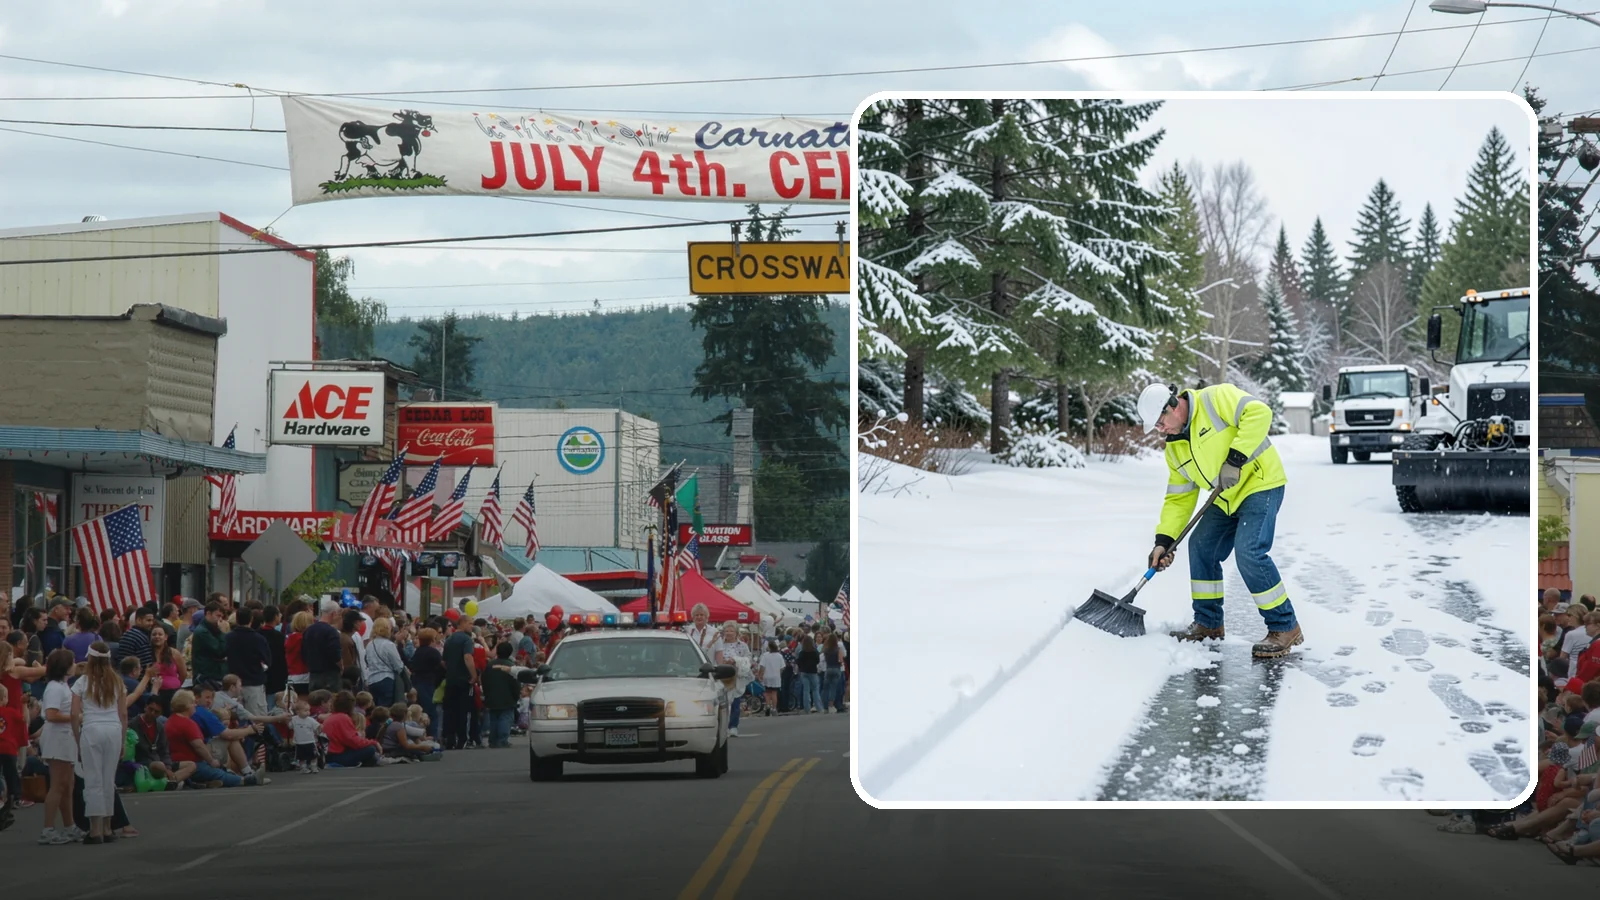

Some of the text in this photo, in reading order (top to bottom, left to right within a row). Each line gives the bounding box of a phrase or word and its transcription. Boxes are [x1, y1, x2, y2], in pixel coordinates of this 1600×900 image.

[481, 141, 605, 192] JULY
[632, 150, 746, 197] 4th.
[697, 254, 850, 280] CROSSWA
[283, 380, 373, 420] ACE
[406, 409, 485, 422] CEDAR LOG
[283, 421, 371, 436] Hardware
[83, 485, 155, 495] St. Vincent de Paul
[81, 503, 154, 521] THT
[688, 526, 741, 535] CRNATION
[699, 535, 730, 543] GLASS
